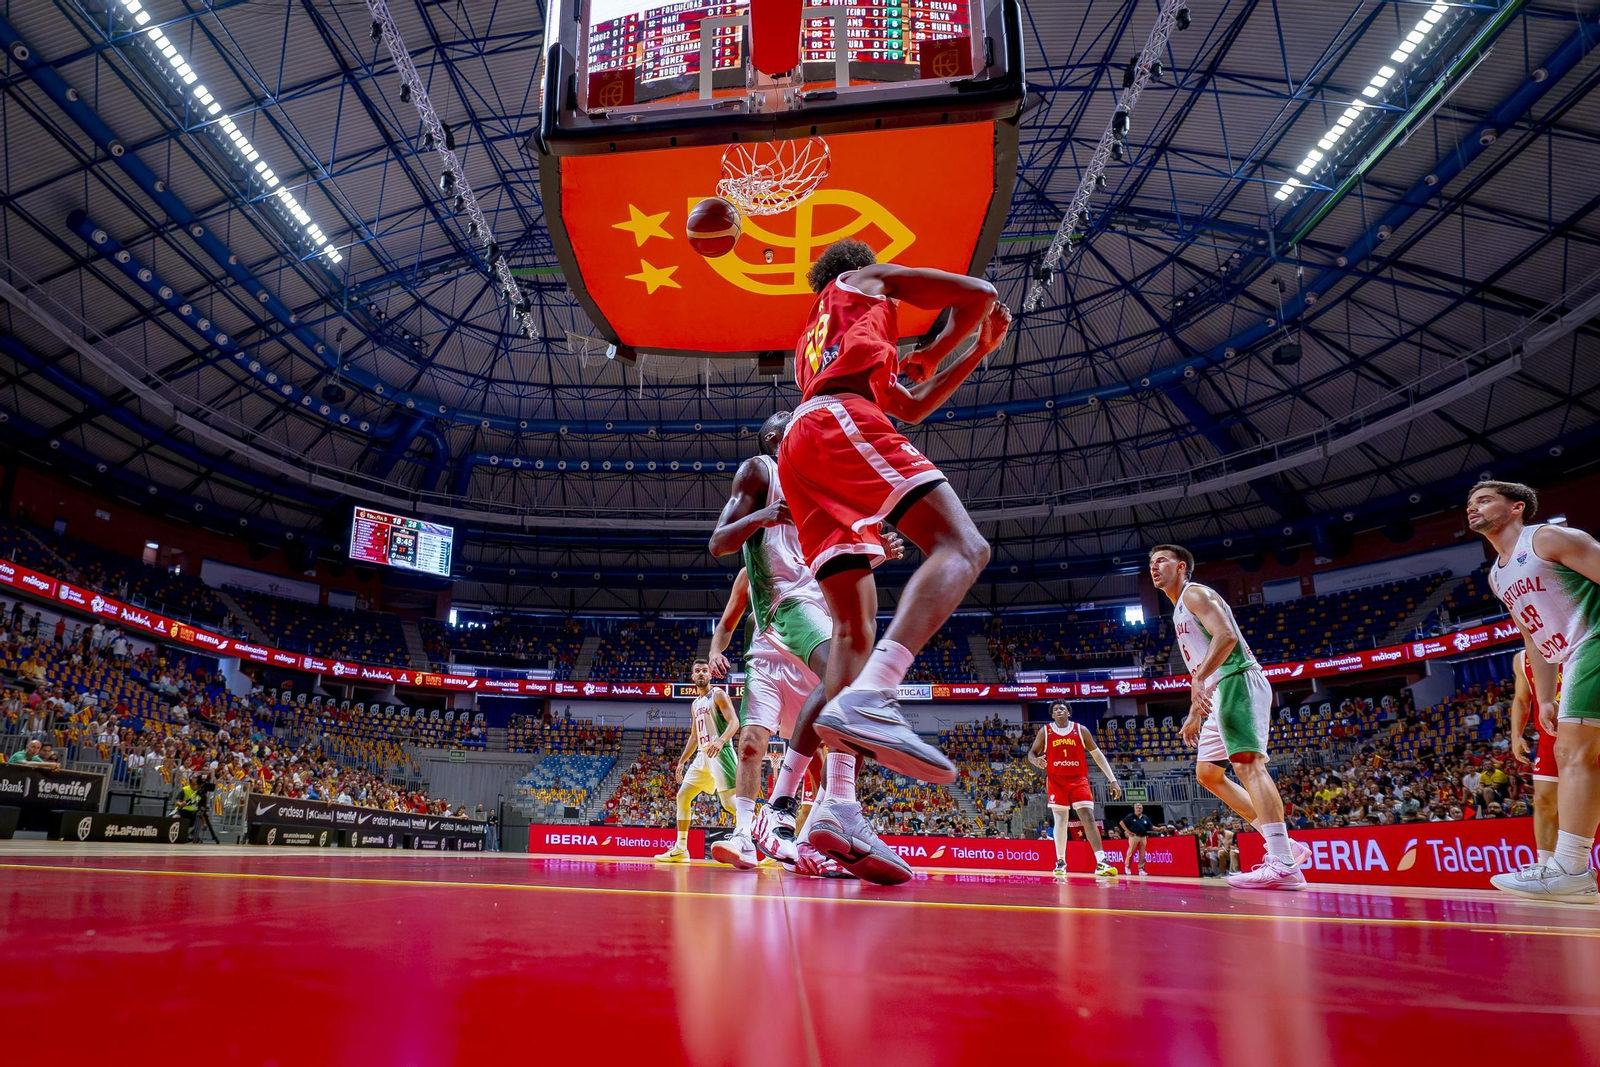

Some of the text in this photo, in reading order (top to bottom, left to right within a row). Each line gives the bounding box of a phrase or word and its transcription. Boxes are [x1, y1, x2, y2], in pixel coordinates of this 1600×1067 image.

[716, 7, 722, 15] F
[930, 12, 949, 21] SILVA
[662, 24, 685, 36] MILLER
[716, 27, 721, 36] F
[716, 38, 720, 46] F
[716, 60, 720, 68] F
[396, 537, 413, 546] 8:45
[196, 633, 220, 645] IBERIA
[234, 643, 268, 656] azulmarino
[1314, 656, 1362, 668] azulmarino
[1262, 668, 1292, 676] BERIA
[1052, 738, 1076, 747] ESPAÑA
[1063, 749, 1067, 757] 1
[278, 806, 304, 818] endesa
[105, 824, 157, 837] #LaFamilia
[545, 834, 598, 846] IBERIA
[615, 836, 650, 847] Talento
[660, 838, 677, 848] bor
[892, 846, 1039, 861] ERIA Talento a bordo
[1158, 850, 1173, 864] bordo
[1299, 837, 1535, 873] BERIA Talento
